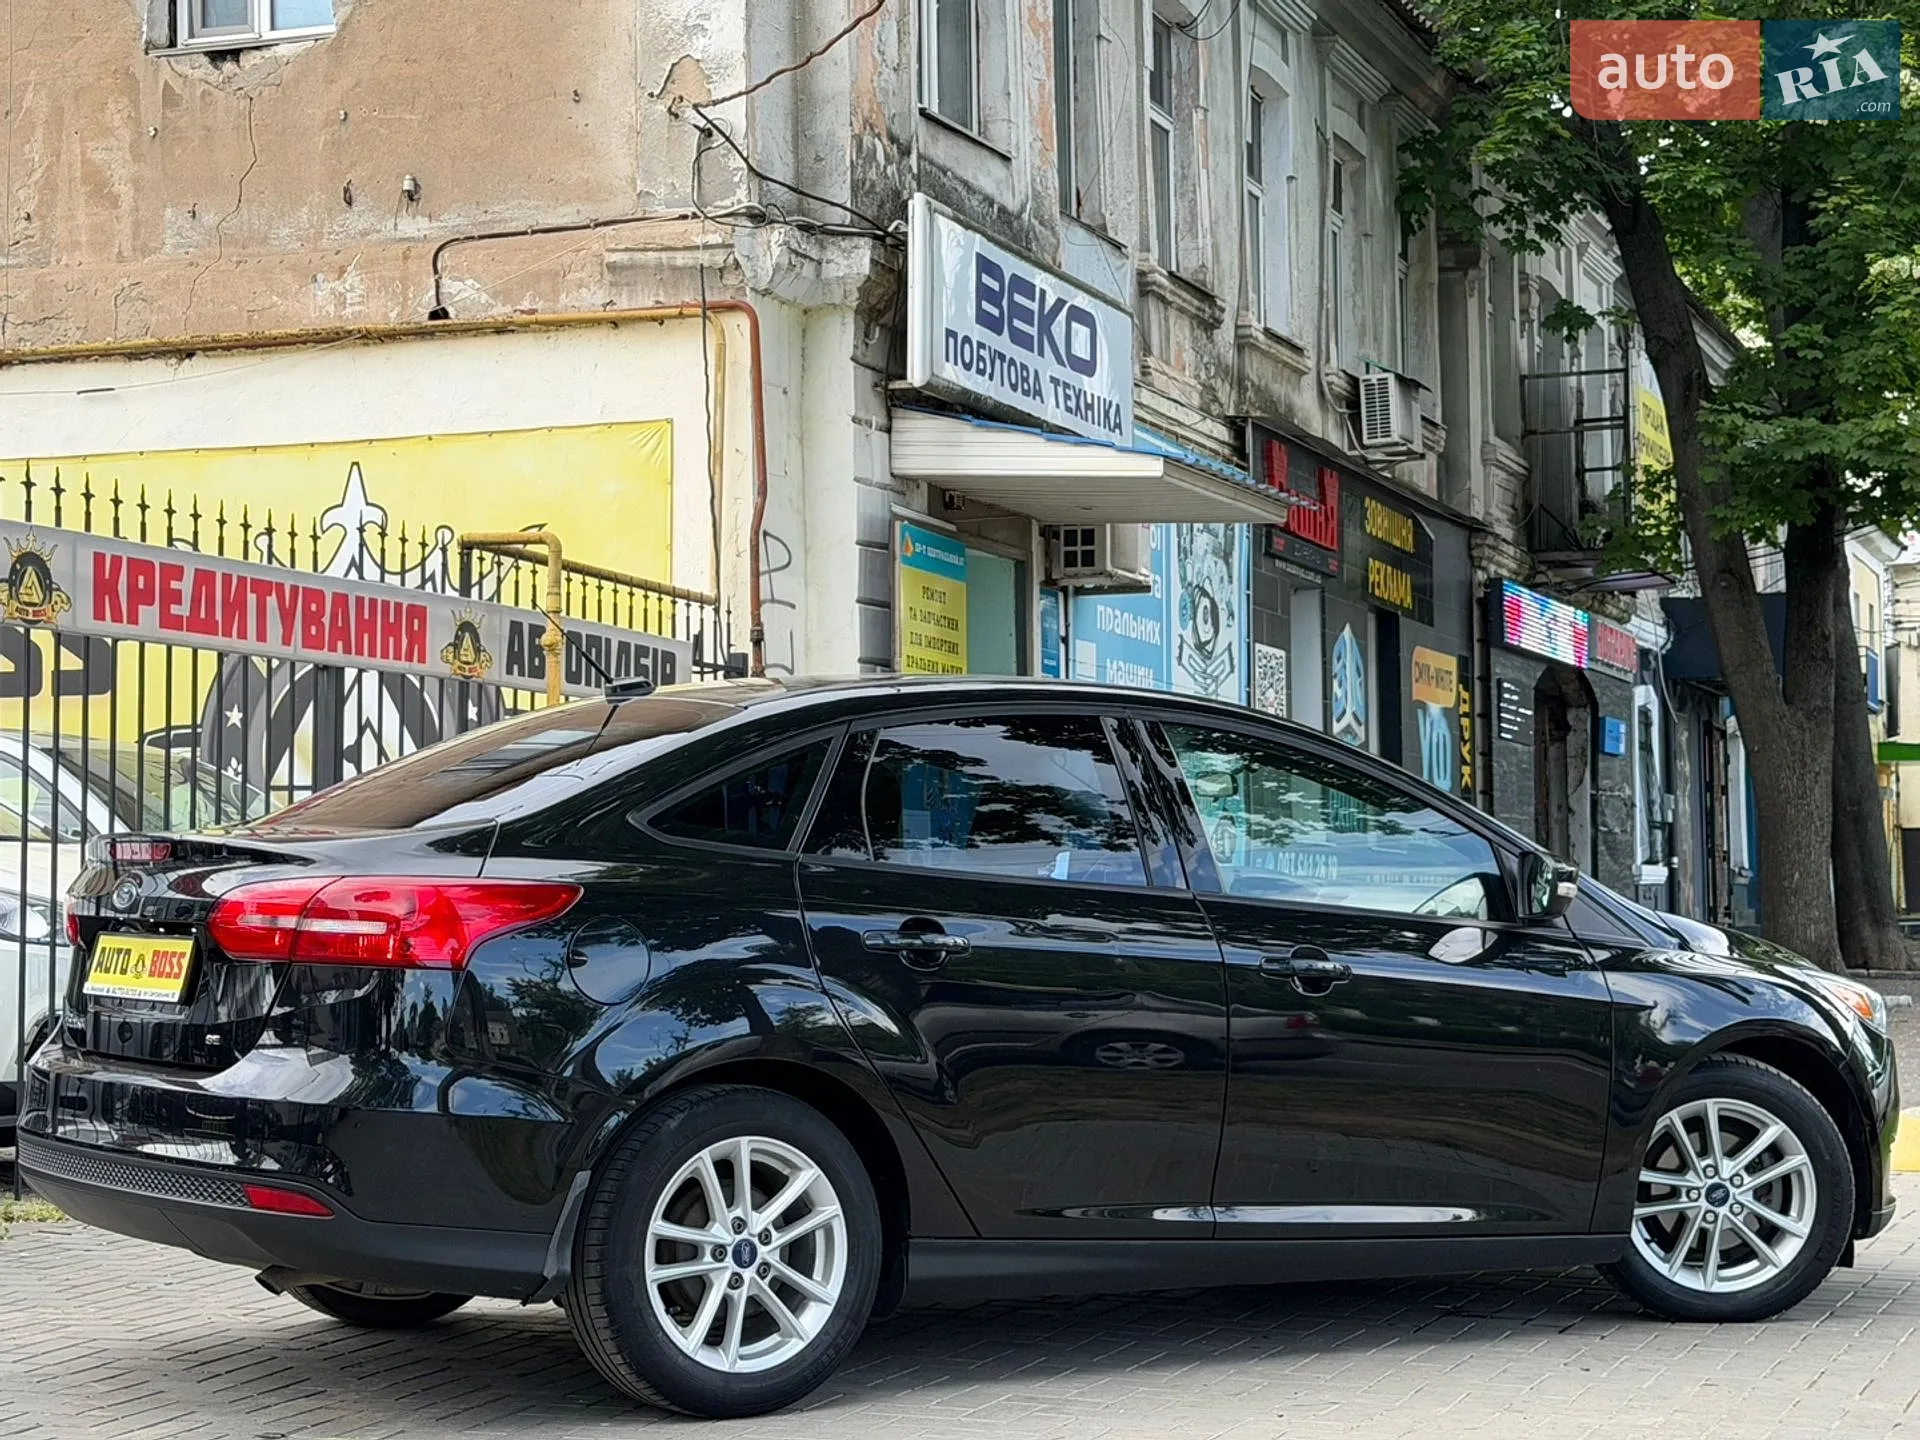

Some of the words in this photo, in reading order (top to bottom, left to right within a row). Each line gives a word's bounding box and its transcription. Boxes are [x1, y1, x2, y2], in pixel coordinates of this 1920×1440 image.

[974, 251, 1098, 379] BEKO
[944, 326, 1045, 405] ПОБУТОВА
[1049, 374, 1123, 437] ТЕХНІКА
[1365, 495, 1416, 555] ЗОВНІШНЯ
[93, 551, 427, 664] КРЕДИТУВАННЯ
[1368, 556, 1413, 611] РЕКЛАМА
[506, 619, 677, 685] АВОПІДБІР
[1096, 604, 1161, 647] пральних
[1458, 684, 1472, 790] ДРУК
[94, 946, 132, 975] AUTO
[148, 949, 187, 980] BOSS
